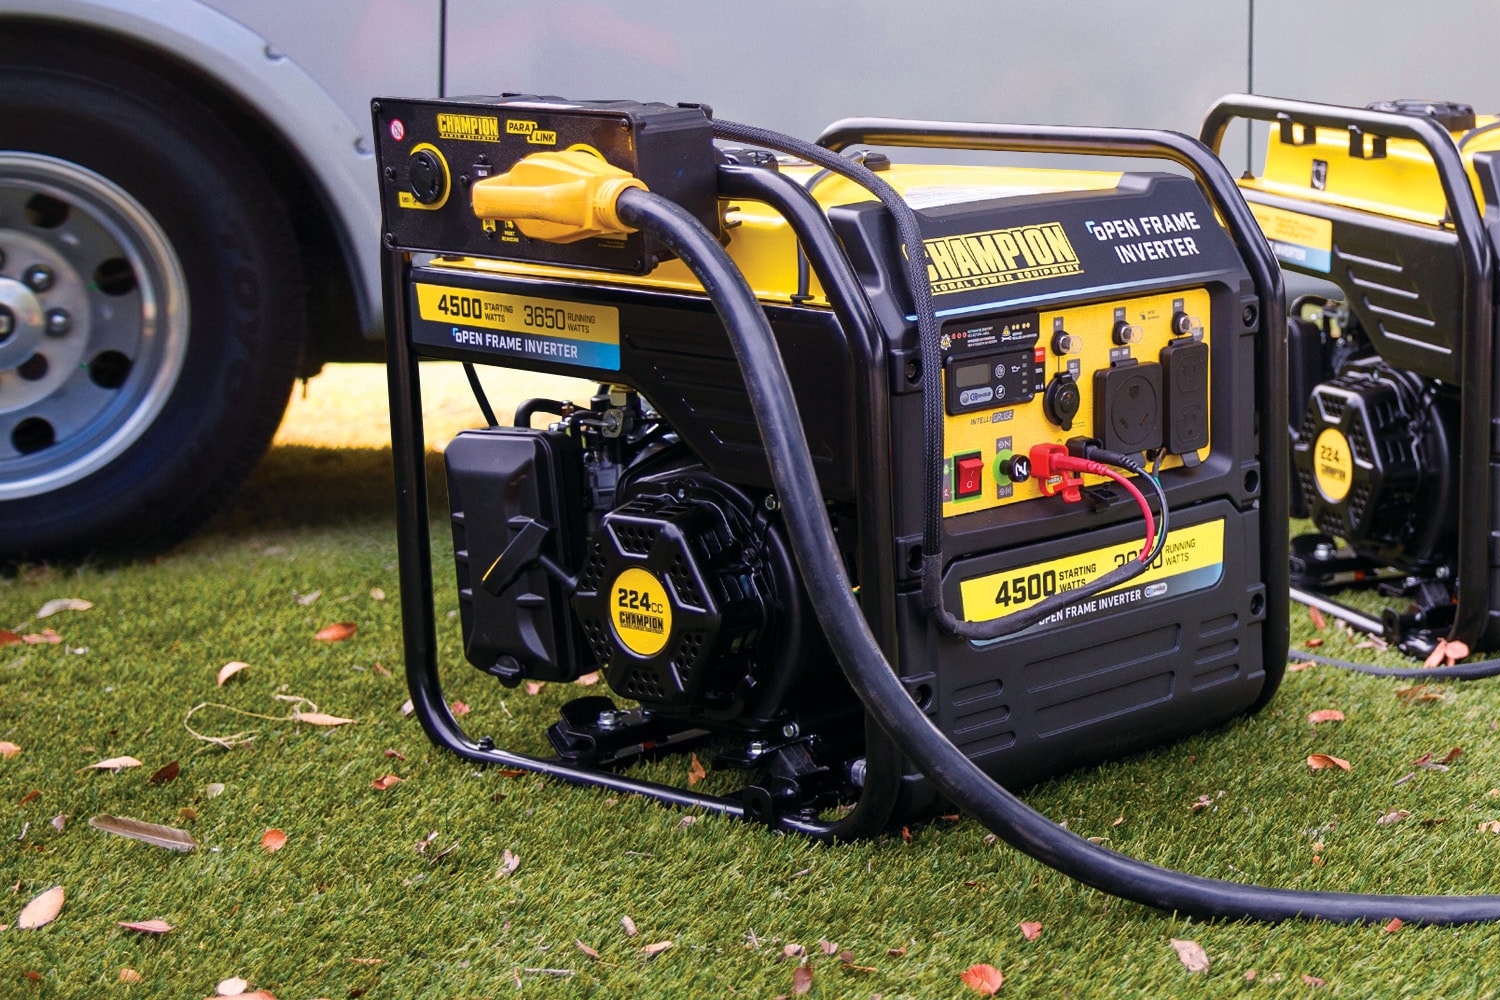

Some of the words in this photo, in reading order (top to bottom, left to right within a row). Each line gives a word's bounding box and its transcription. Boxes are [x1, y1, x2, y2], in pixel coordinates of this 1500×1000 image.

[438, 114, 498, 136] CHAMPION
[508, 122, 530, 132] PARA
[535, 132, 554, 142] LINK
[1092, 218, 1141, 241] OPEN
[1139, 211, 1201, 235] FRAME
[1113, 236, 1200, 264] INVERTER
[931, 281, 971, 293] LOBAL
[974, 273, 1014, 287] POWER
[1016, 264, 1080, 281] EQUIPMENT
[437, 294, 482, 320] 4500
[484, 302, 513, 314] STARTING
[523, 305, 566, 331] 3650
[567, 312, 596, 324] RUNNING
[484, 313, 506, 323] WATTS
[567, 323, 590, 334] WATTS
[455, 330, 483, 346] OPEN
[485, 333, 523, 351] FRAME
[524, 338, 578, 359] INVERTER
[995, 569, 1057, 608] 4500
[1058, 563, 1097, 581] STARTING
[1165, 538, 1196, 555] RUNNING
[1059, 578, 1087, 593] WATTS
[1165, 552, 1190, 566] WATTS
[1065, 600, 1097, 619] FRAME
[1098, 589, 1142, 611] INVERTER
[619, 611, 664, 630] CHAMPION
